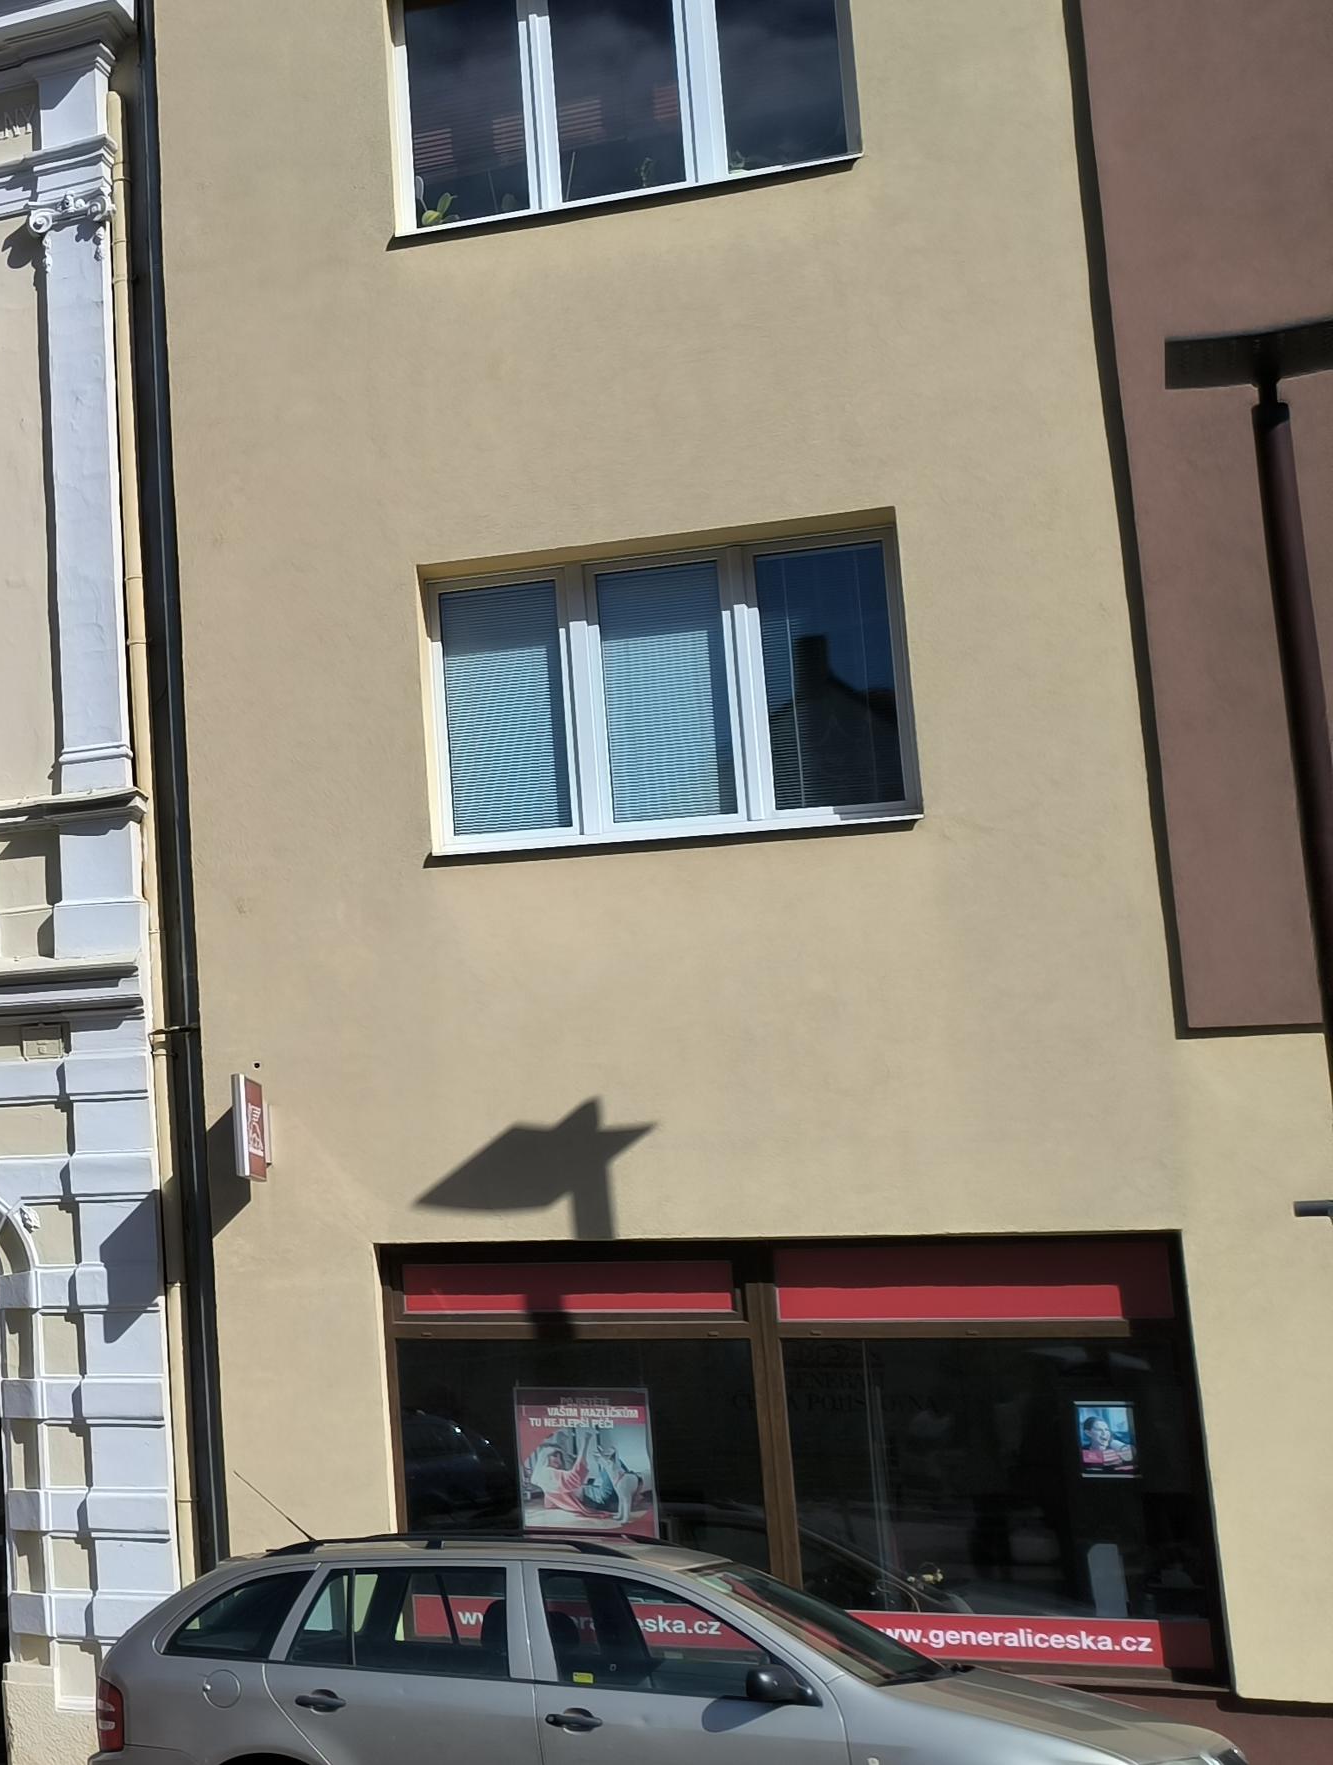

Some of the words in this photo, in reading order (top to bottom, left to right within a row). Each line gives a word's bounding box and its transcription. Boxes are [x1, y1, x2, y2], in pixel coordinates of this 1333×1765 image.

[547, 1405, 579, 1418] VAŠIM
[580, 1406, 639, 1418] MAZLÍČKŮM
[529, 1417, 542, 1427] TU
[544, 1416, 590, 1428] NEJLEPŠÍ
